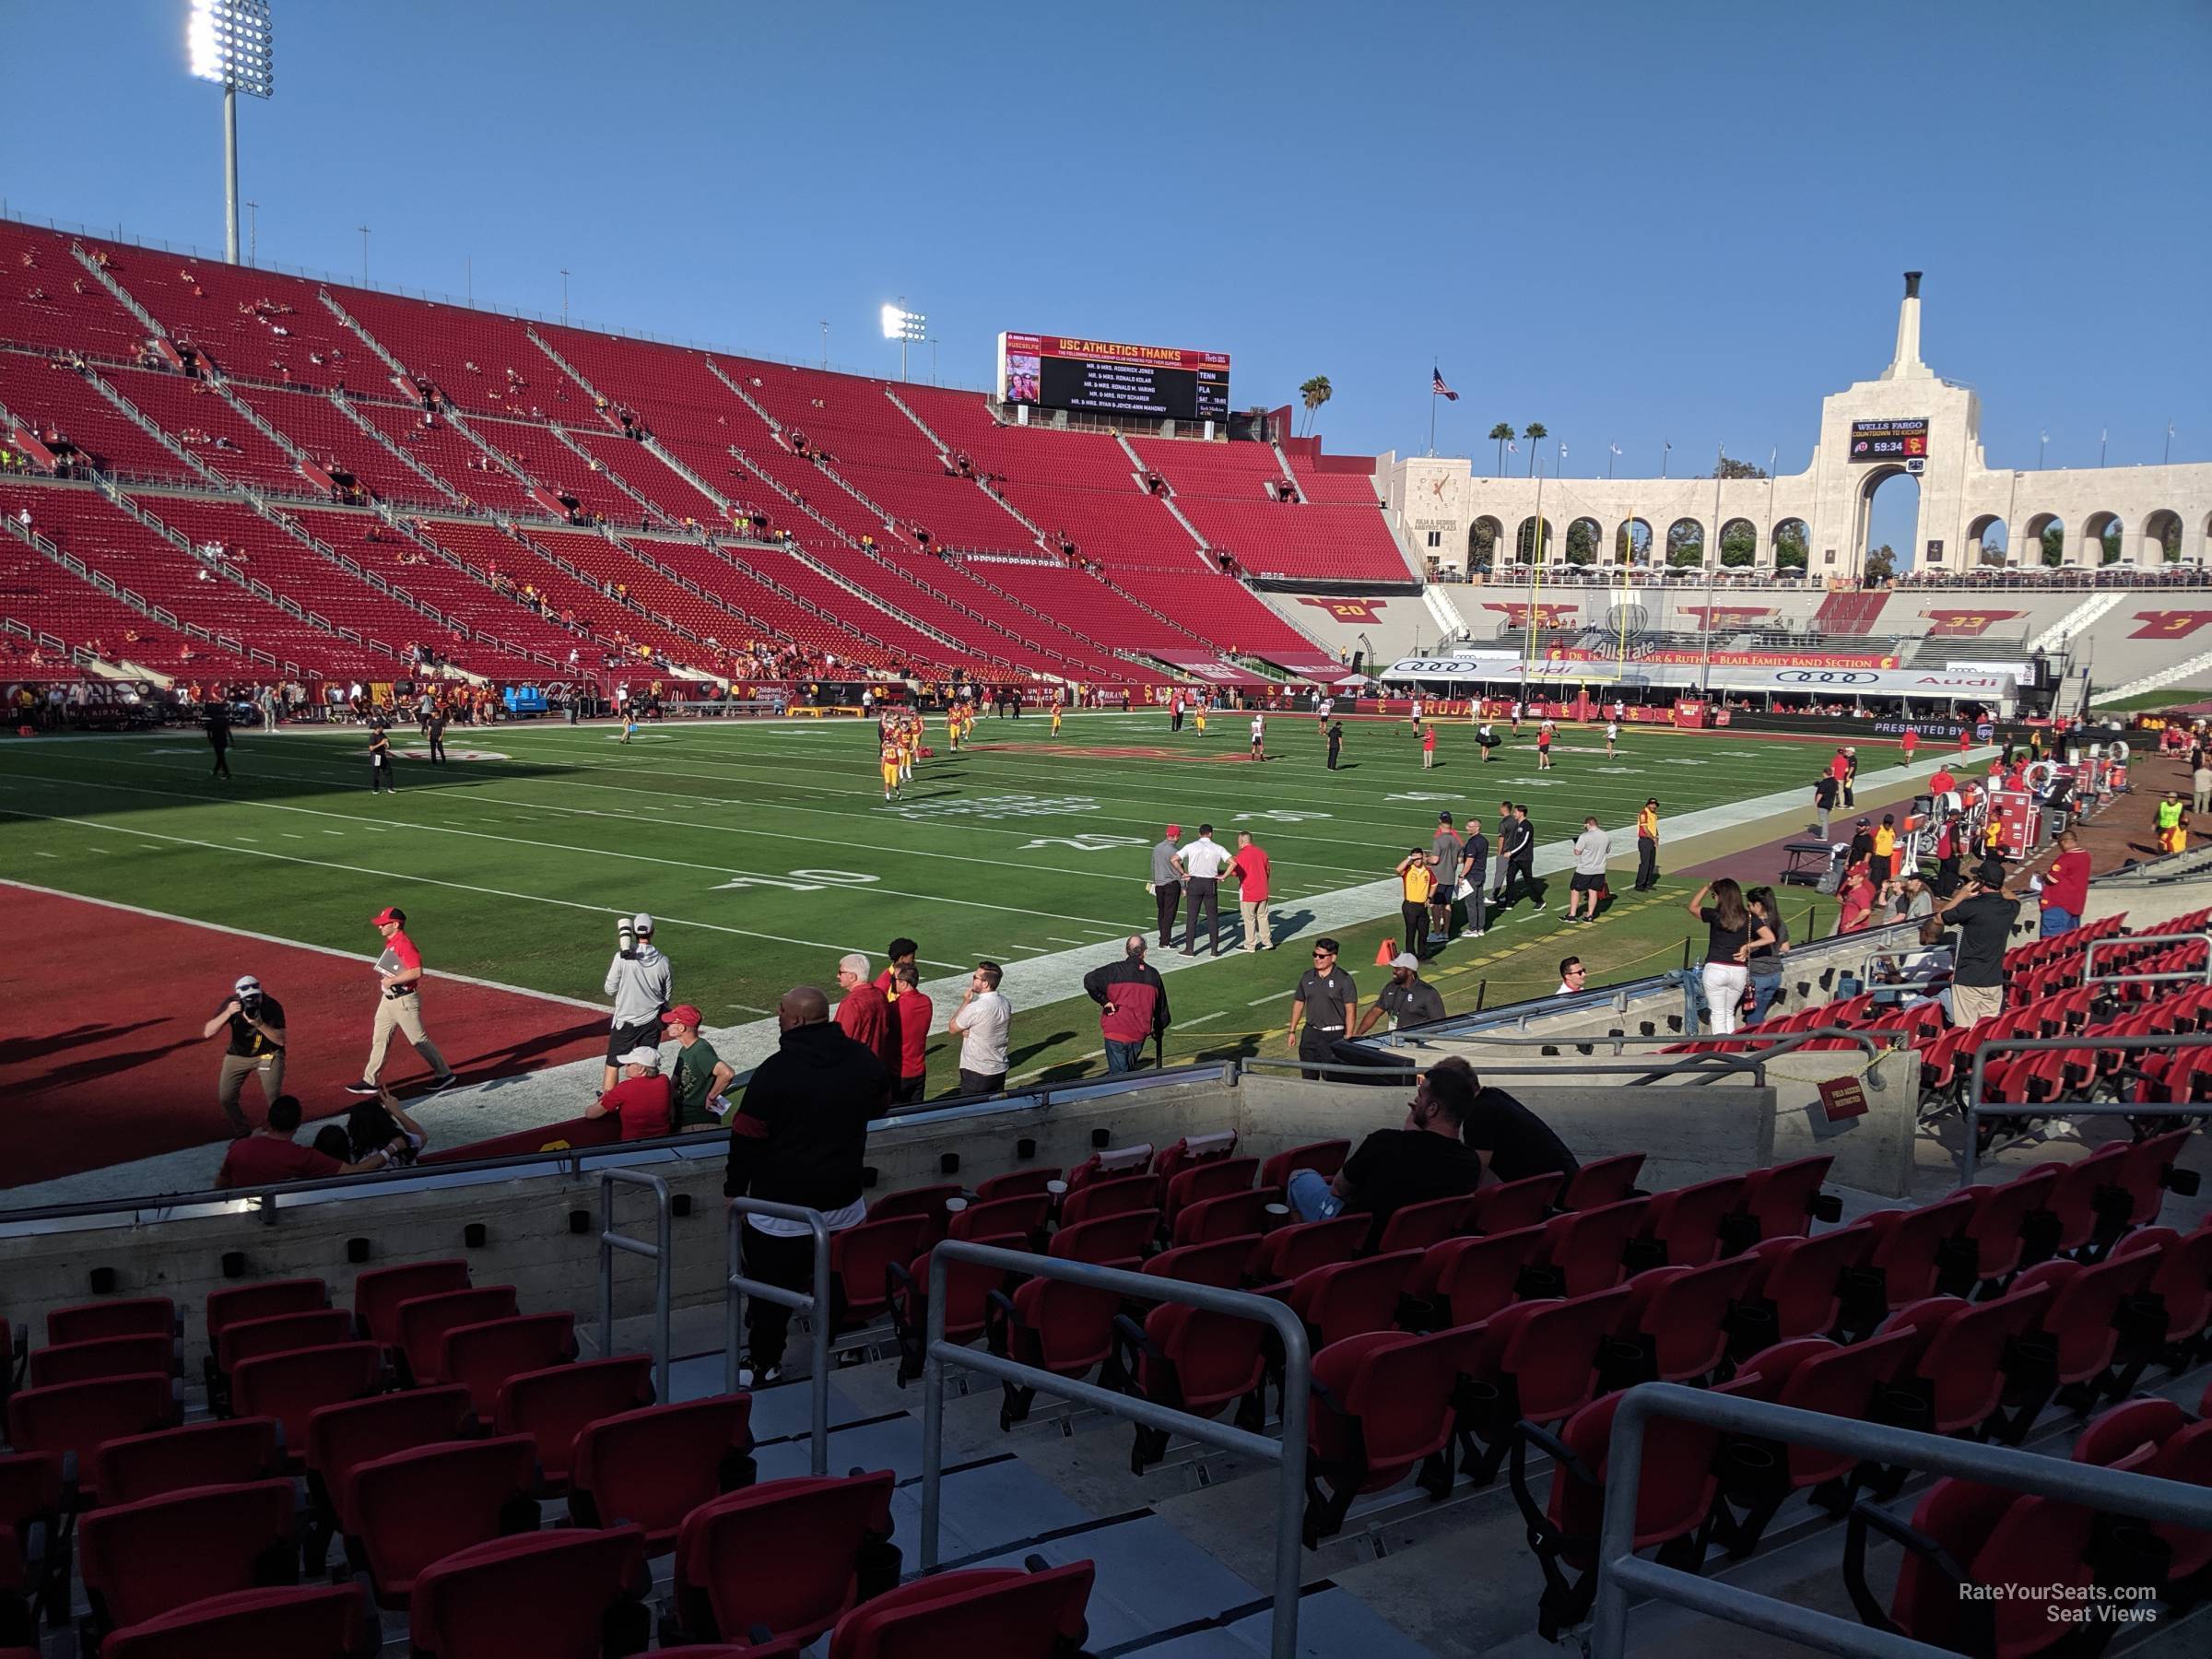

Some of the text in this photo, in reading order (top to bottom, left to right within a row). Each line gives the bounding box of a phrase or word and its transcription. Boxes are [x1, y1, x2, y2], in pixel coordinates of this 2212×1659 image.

[1060, 339, 1182, 360] USC ATHLETICS THANKS
[1891, 421, 1923, 429] FARGO
[1874, 441, 1903, 452] 59:34
[1909, 461, 1922, 470] 25
[1332, 605, 1366, 616] 20
[1949, 617, 1987, 628] 33
[2164, 618, 2192, 629] 3
[1593, 641, 1655, 660] Allstate
[1676, 654, 1703, 664] RUTH
[1720, 656, 1749, 665] BLAIR
[1752, 656, 1789, 666] FAMILY
[1792, 657, 1823, 667] BAND
[1825, 657, 1872, 668] SECTION
[1505, 665, 1573, 675] Audi
[1914, 677, 1998, 687] Audi
[756, 686, 782, 694] Children's
[1424, 701, 1503, 717] ROJANS
[1875, 723, 1993, 739] PRESENTED BY ups
[1029, 833, 1150, 851] 20
[732, 869, 881, 891] 10
